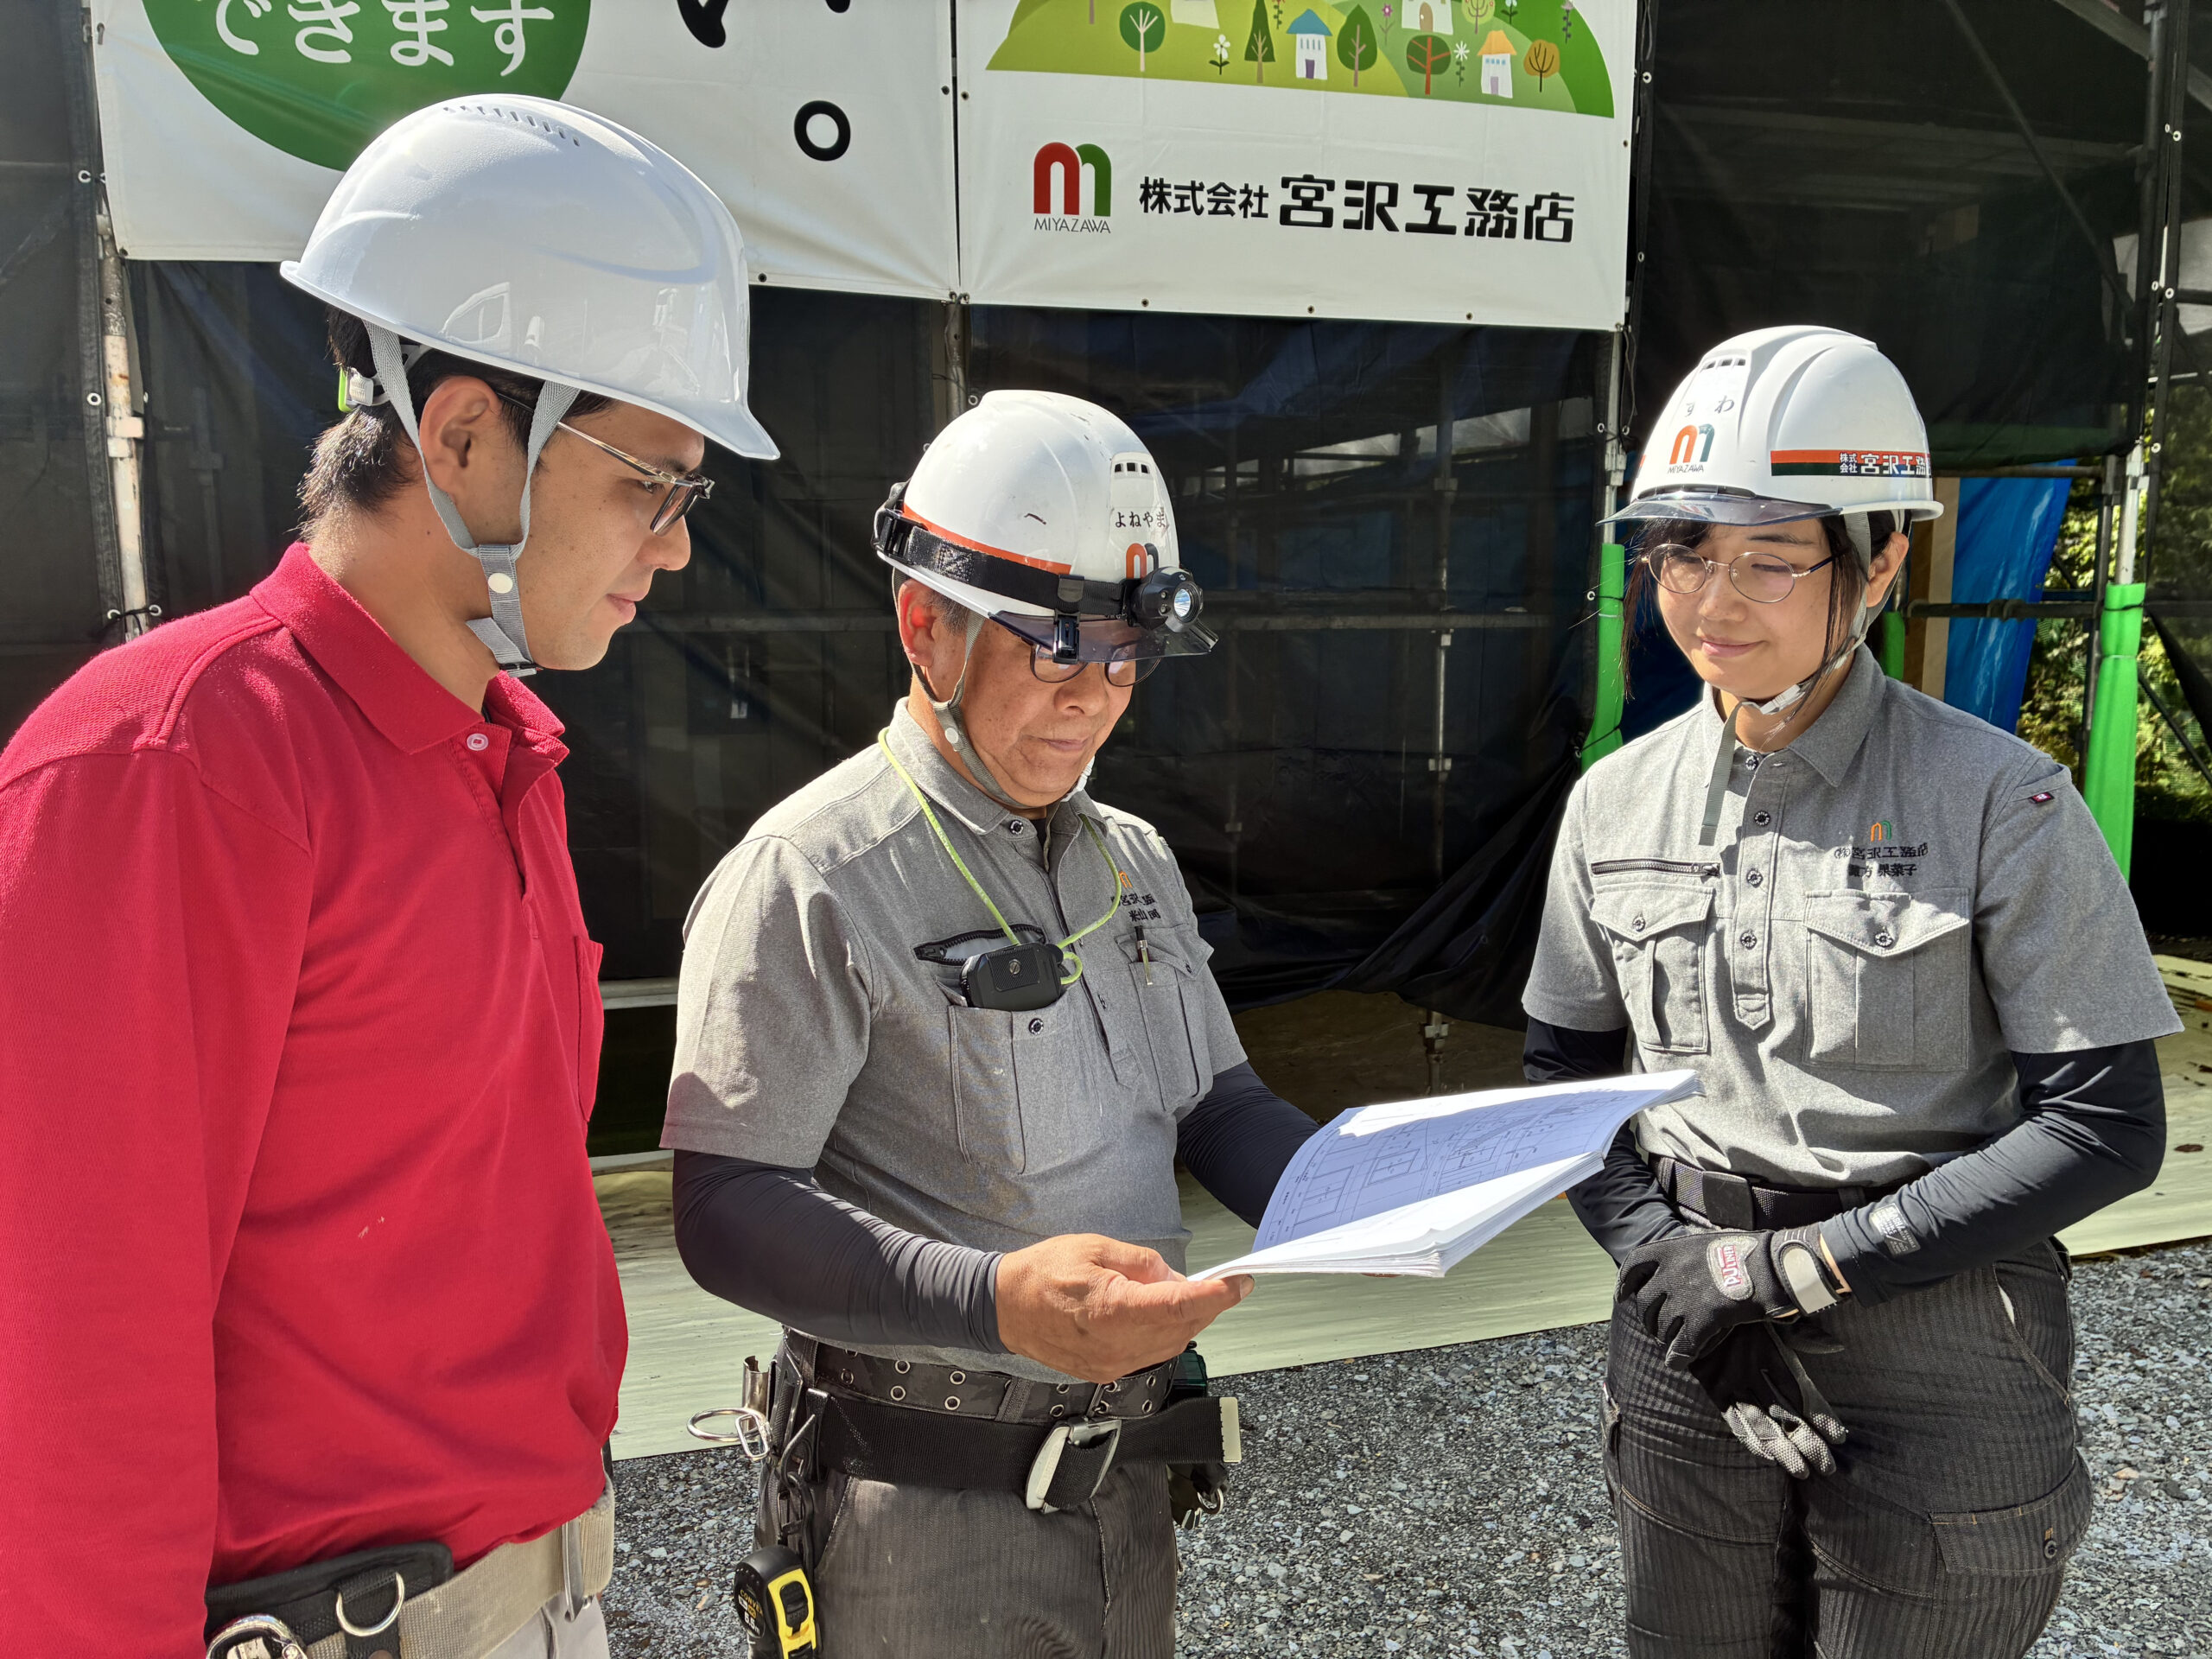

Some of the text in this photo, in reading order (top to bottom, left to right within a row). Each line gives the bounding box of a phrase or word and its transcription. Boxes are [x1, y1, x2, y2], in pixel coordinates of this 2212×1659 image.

[216, 0, 554, 77] できます
[1034, 217, 1111, 234] MIYAZAWA
[1140, 174, 1575, 243] 株式会社 宮沢工務店
[1668, 464, 1705, 474] MIYAZAWA
